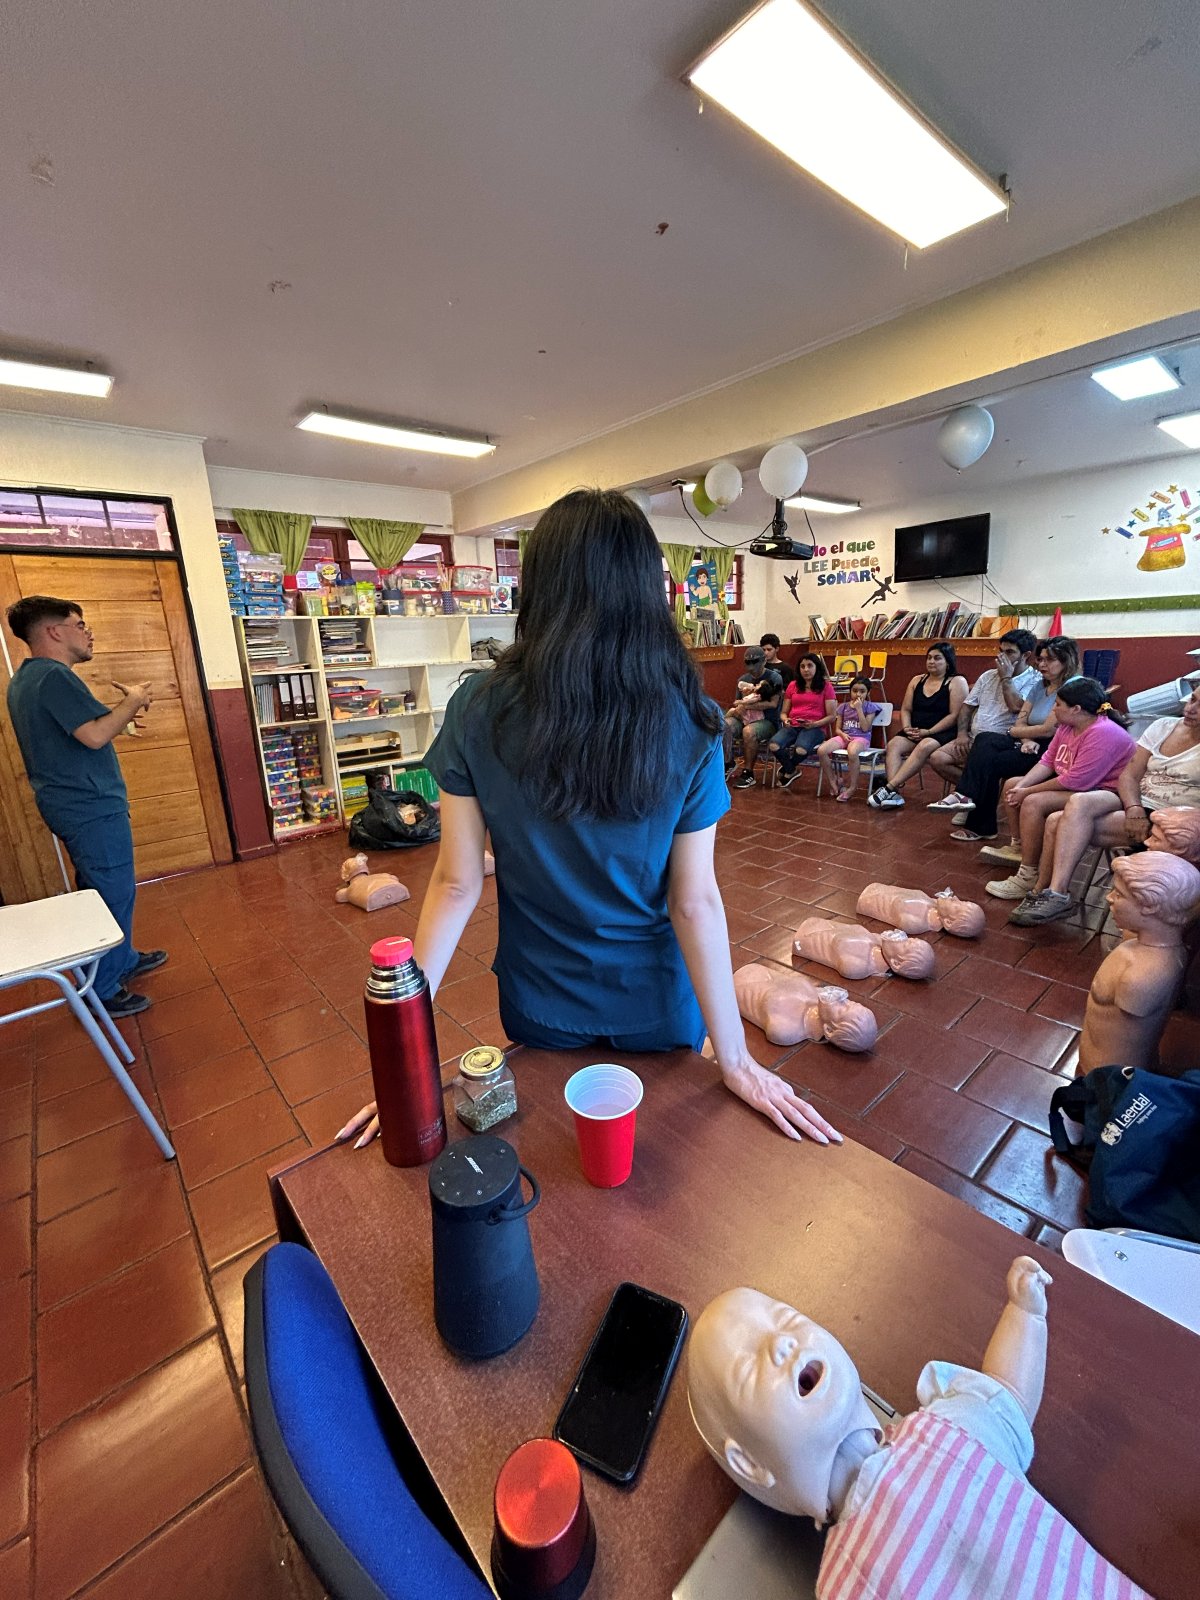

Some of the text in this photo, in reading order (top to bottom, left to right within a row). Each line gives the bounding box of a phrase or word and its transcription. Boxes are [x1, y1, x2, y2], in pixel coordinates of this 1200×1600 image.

[830, 541, 844, 554] el
[846, 540, 876, 554] que
[803, 555, 879, 574] LEE Puede
[1115, 1092, 1151, 1127] Laerdal
